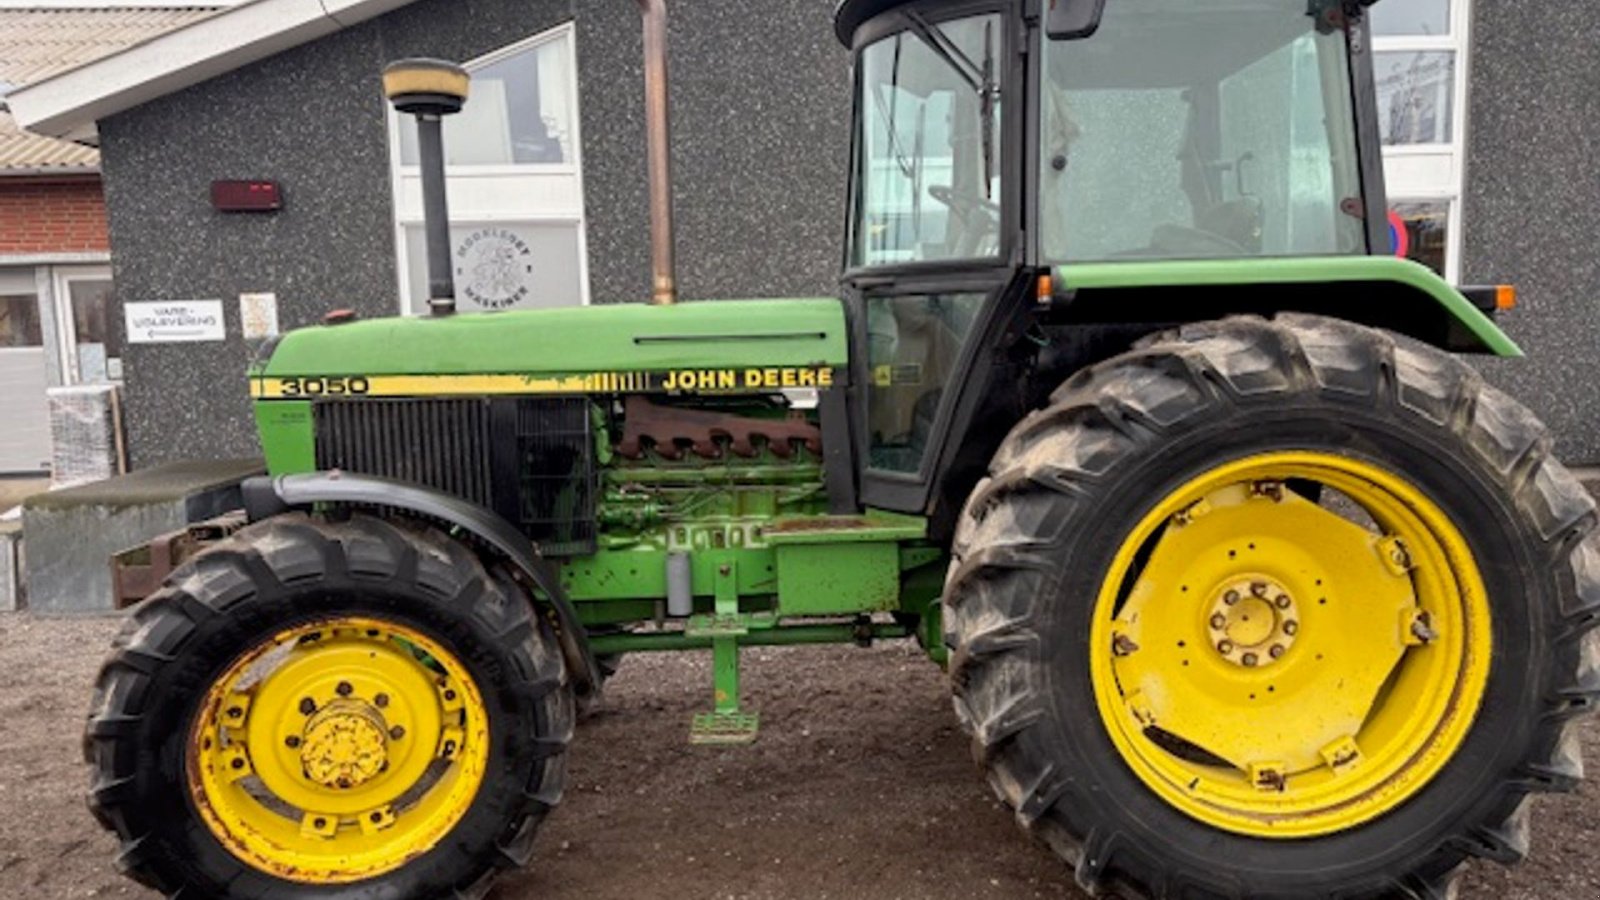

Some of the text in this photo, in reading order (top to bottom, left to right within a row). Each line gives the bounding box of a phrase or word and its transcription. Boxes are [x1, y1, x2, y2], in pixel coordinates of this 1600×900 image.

[280, 377, 370, 395] 3050
[663, 367, 834, 390] JOHN DEERE
